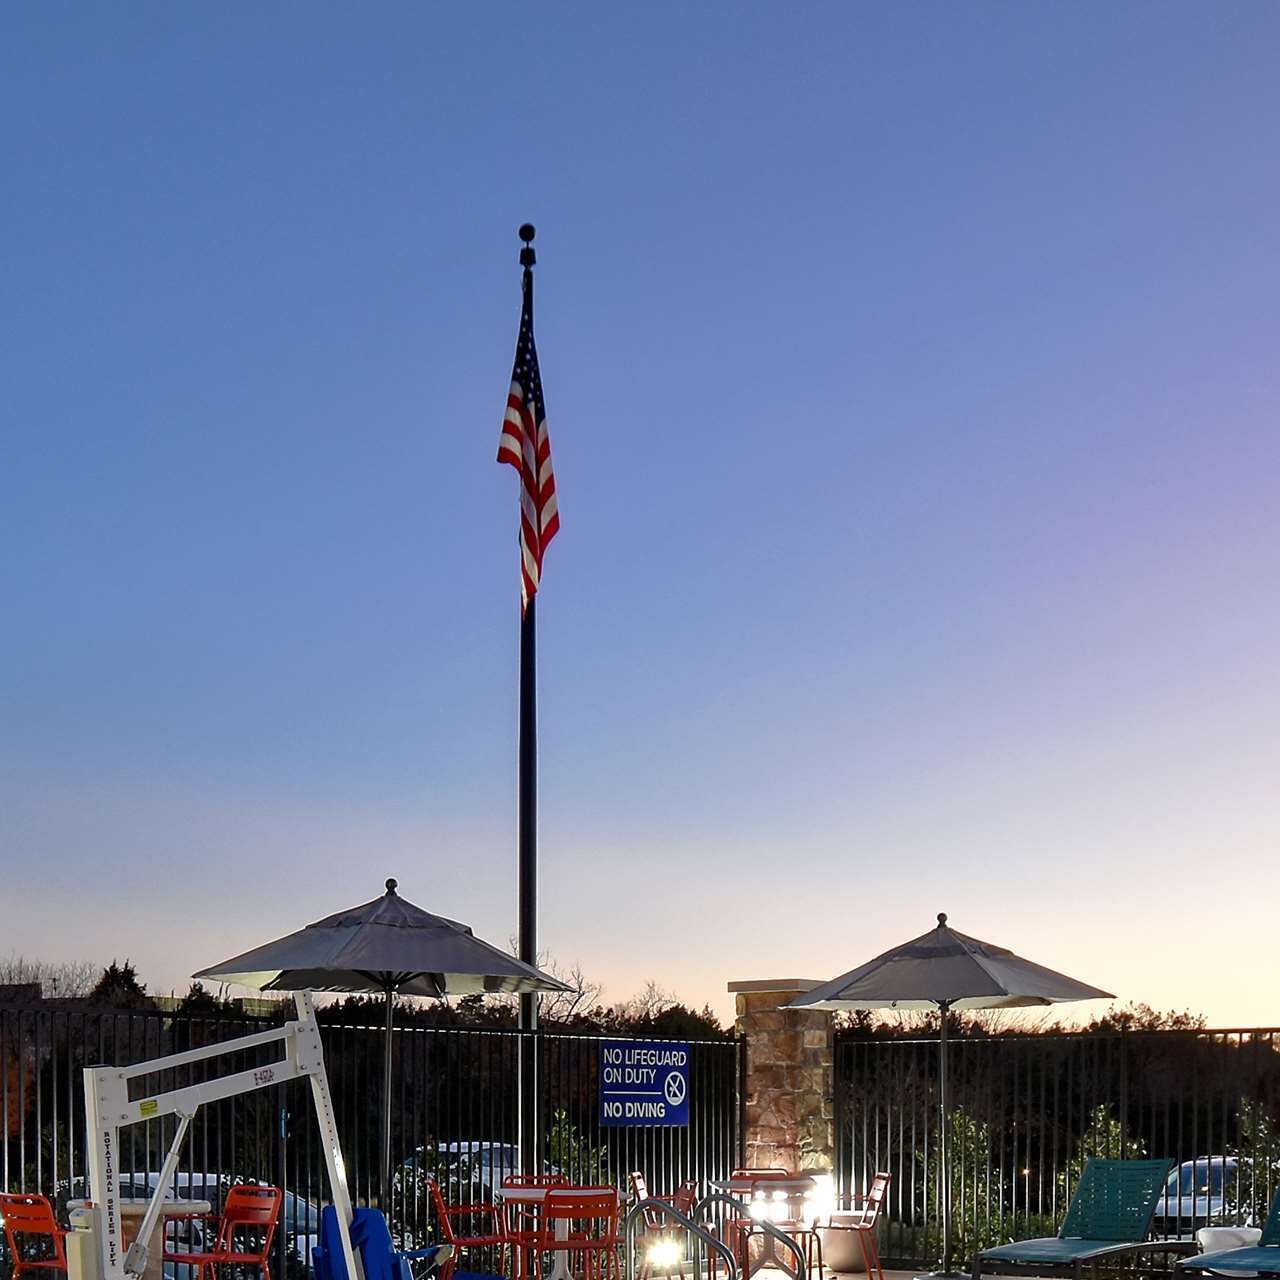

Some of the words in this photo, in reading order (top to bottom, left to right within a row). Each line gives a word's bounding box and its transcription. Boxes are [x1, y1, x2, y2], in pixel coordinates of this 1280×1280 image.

[604, 1048, 622, 1064] NO
[625, 1049, 686, 1066] LIFEGUARD
[603, 1067, 622, 1084] ON
[625, 1068, 657, 1084] DUTY
[604, 1102, 622, 1117] NO
[625, 1102, 665, 1117] DIVING
[104, 1131, 113, 1193] ROTATIONAL
[107, 1199, 115, 1235] SERIES
[109, 1241, 117, 1267] LIFT
